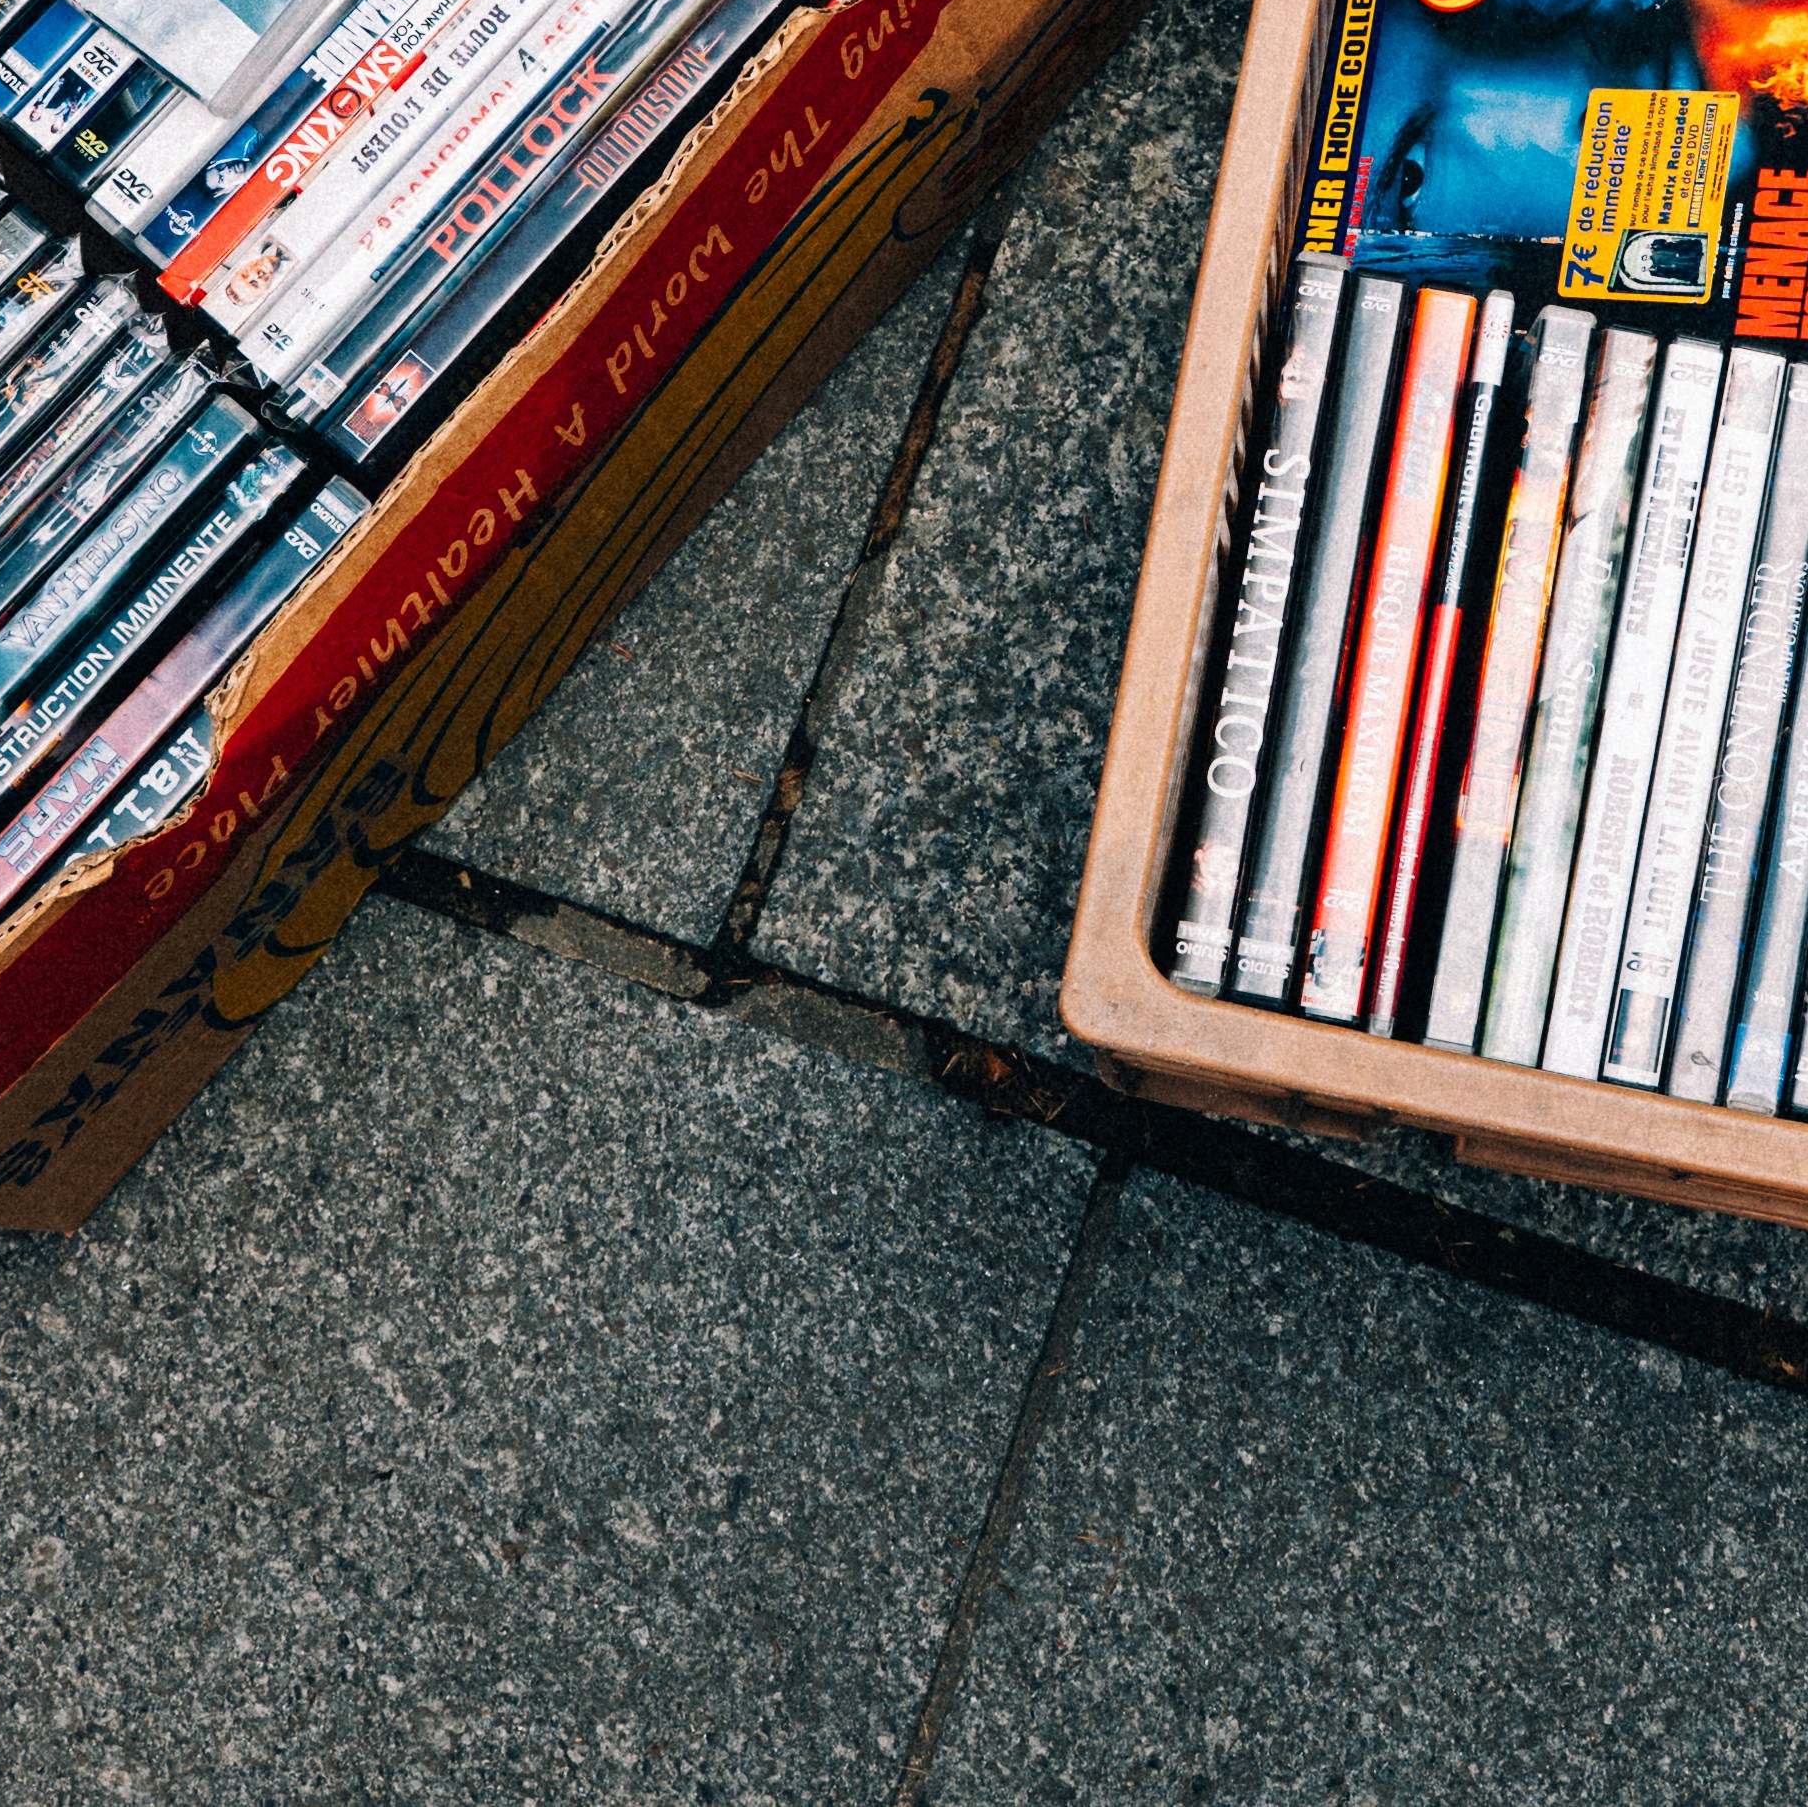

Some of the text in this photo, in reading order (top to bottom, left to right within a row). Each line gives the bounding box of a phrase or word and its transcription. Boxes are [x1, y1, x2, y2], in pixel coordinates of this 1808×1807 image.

[390, 17, 415, 43] FOR
[400, 23, 430, 54] YOU
[421, 66, 453, 99] DE
[447, 1, 511, 69] ROUTE
[351, 95, 425, 174] L'OUEST
[355, 78, 517, 252] PARANORMAL
[511, 45, 547, 81] 4
[422, 53, 621, 265] POLLOCK
[575, 43, 713, 190] MOSQUITO
[737, 103, 829, 208] The
[1657, 95, 1689, 225] Matrix Reloaded
[1678, 123, 1700, 199] et de ce DVD
[117, 167, 155, 203] DVD
[594, 224, 740, 393] World
[548, 402, 597, 453] A
[310, 500, 344, 532] STUDIO
[1661, 477, 1697, 569] LE BON
[110, 509, 238, 646] IMMINENTE
[300, 466, 537, 740] Healthier
[1202, 445, 1313, 802] SIMPATICO
[1337, 541, 1413, 838] RISQUE MAXIMUM
[1698, 552, 1796, 905] THE CONTENDER
[138, 752, 295, 911] Place
